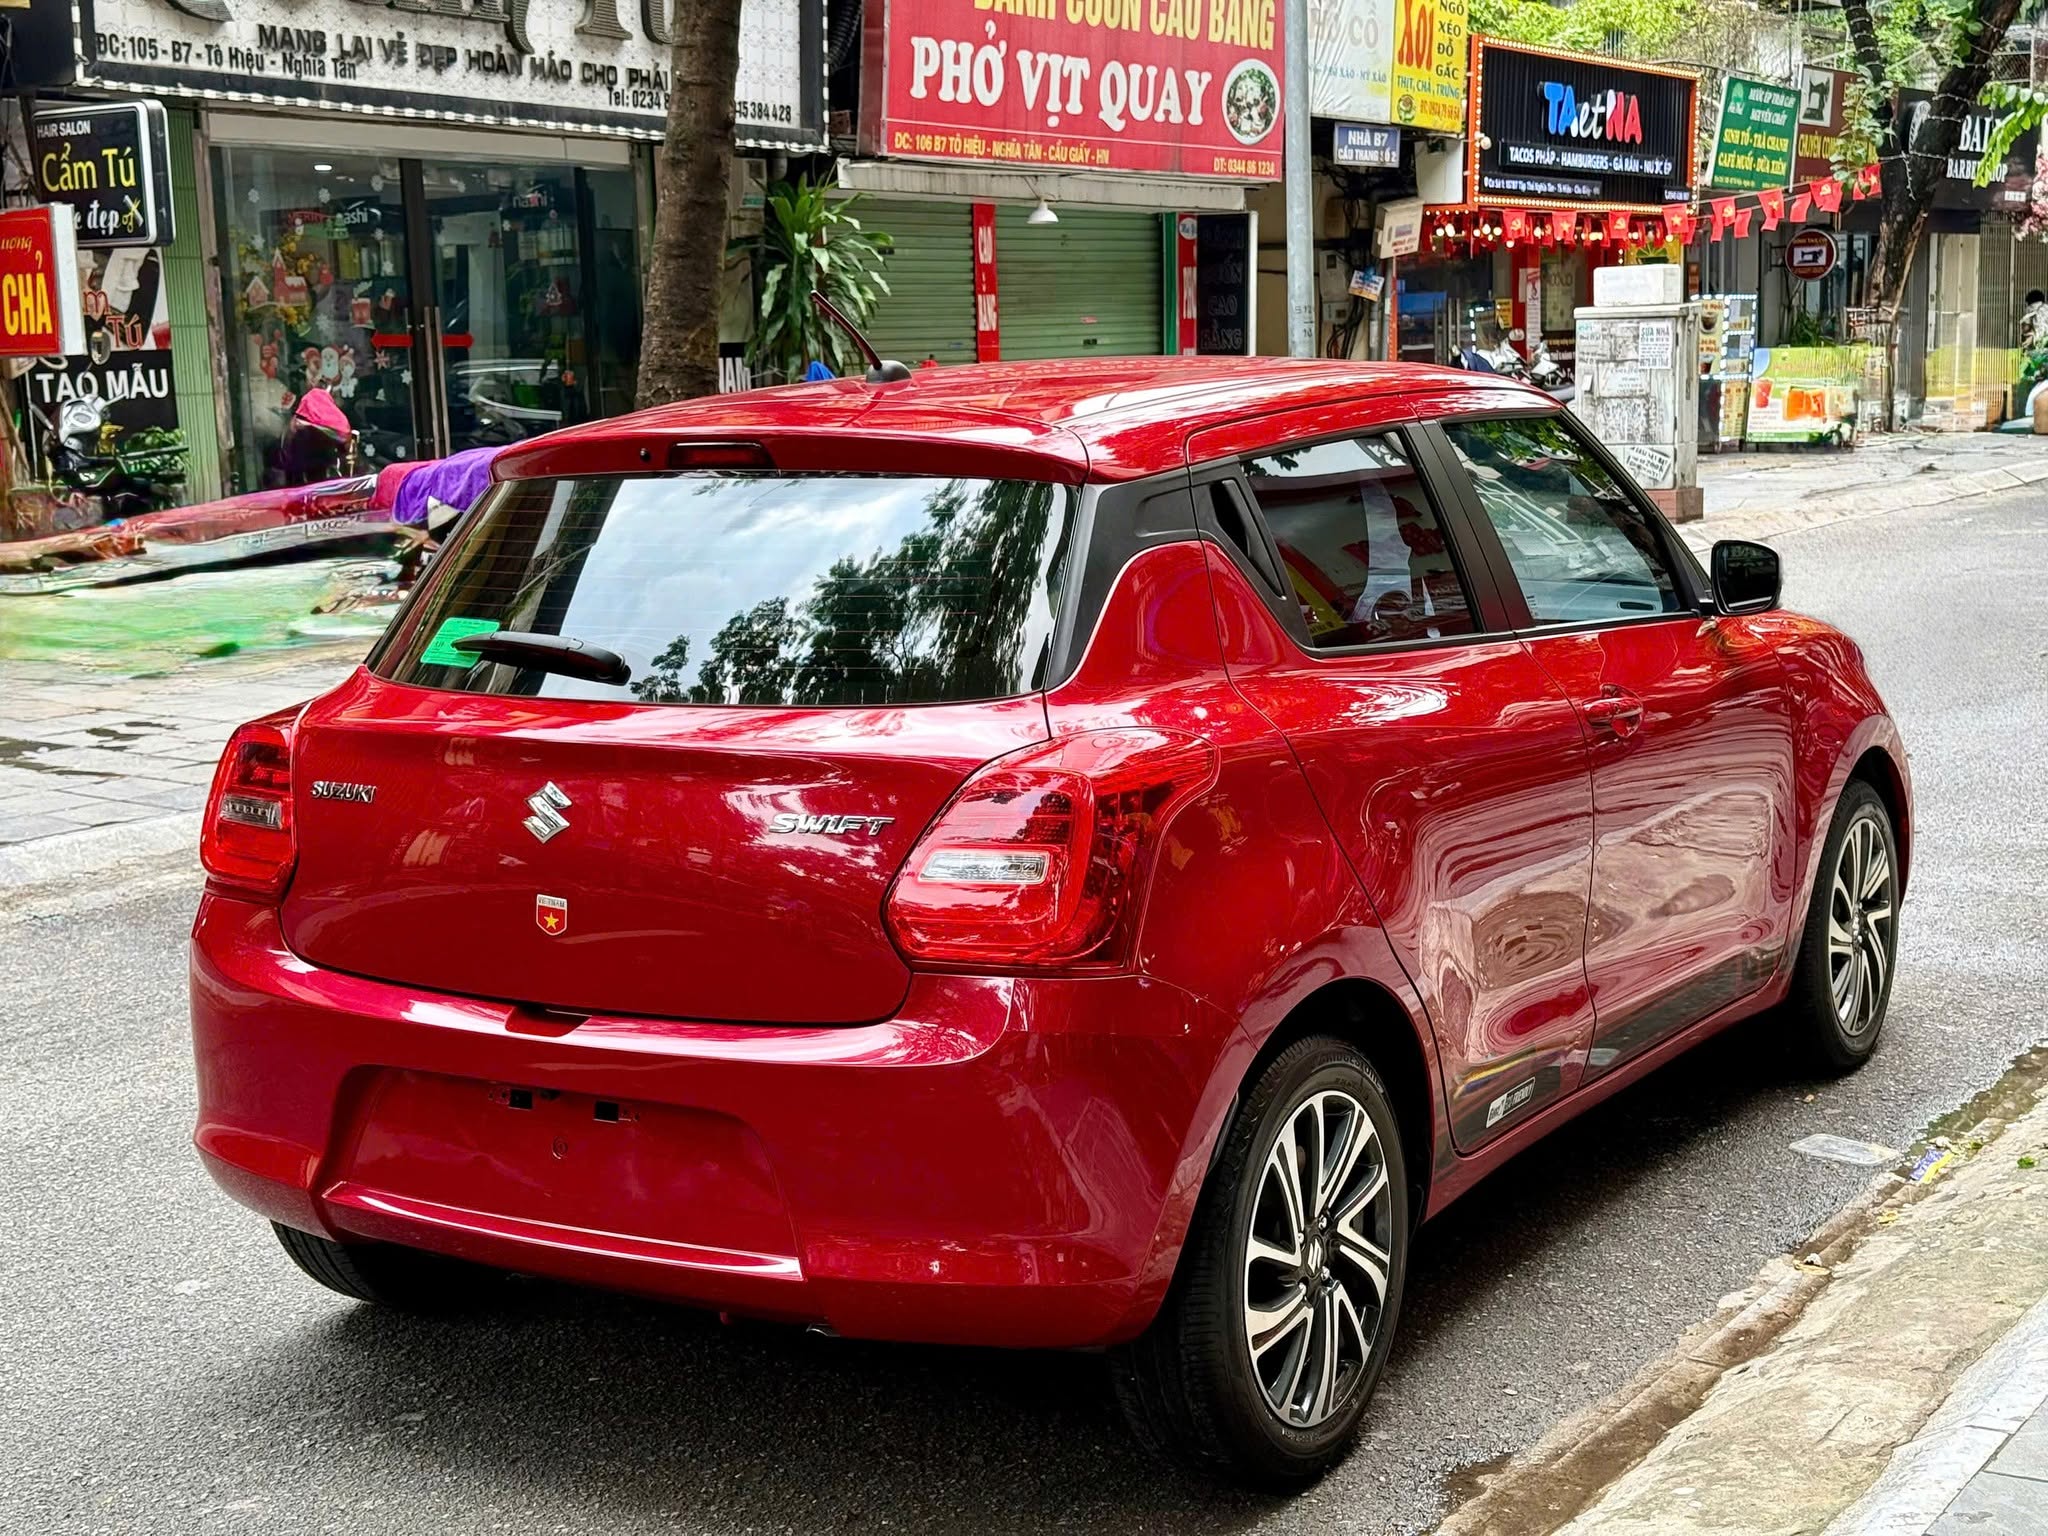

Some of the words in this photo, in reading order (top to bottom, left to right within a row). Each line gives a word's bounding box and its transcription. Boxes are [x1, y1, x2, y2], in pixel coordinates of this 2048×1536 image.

[581, 62, 617, 86] CHO
[910, 20, 1007, 107] PHỞ
[1016, 49, 1091, 128] VỊT
[1099, 60, 1212, 132] QUAY
[607, 87, 629, 107] Tel:
[37, 124, 58, 138] HAIR
[60, 120, 91, 137] SALON
[1348, 128, 1371, 147] NHÀ
[1374, 132, 1388, 147] B7
[42, 142, 98, 192] Cẩm
[102, 146, 136, 188] Tú
[1096, 148, 1110, 164] HN
[1355, 149, 1379, 162] THANG
[1509, 146, 1534, 163] TACOS
[1535, 146, 1556, 166] PHÁP
[1561, 152, 1609, 170] HAMBURGERS
[87, 200, 120, 235] đẹp
[2, 250, 53, 336] CHẢ
[106, 313, 143, 349] Tú
[105, 362, 169, 401] MẪU
[310, 781, 377, 803] SUZUKI
[769, 813, 895, 836] SWIFT
